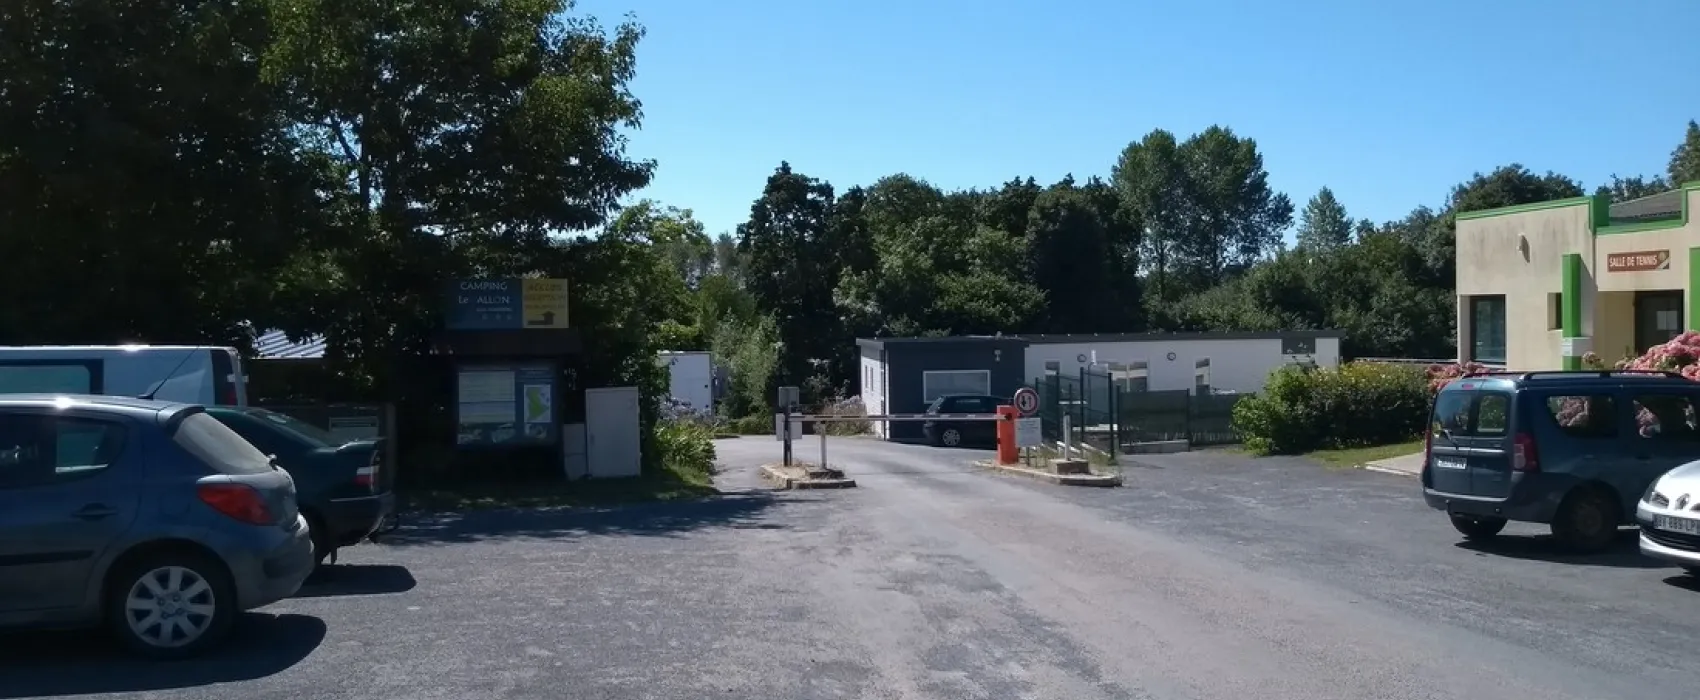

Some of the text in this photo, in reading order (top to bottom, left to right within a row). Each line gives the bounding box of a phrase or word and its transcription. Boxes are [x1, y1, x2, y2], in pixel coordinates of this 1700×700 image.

[1609, 256, 1657, 267] SALLE DE TENNIS
[460, 281, 508, 290] CAMPING
[458, 295, 469, 304] Le
